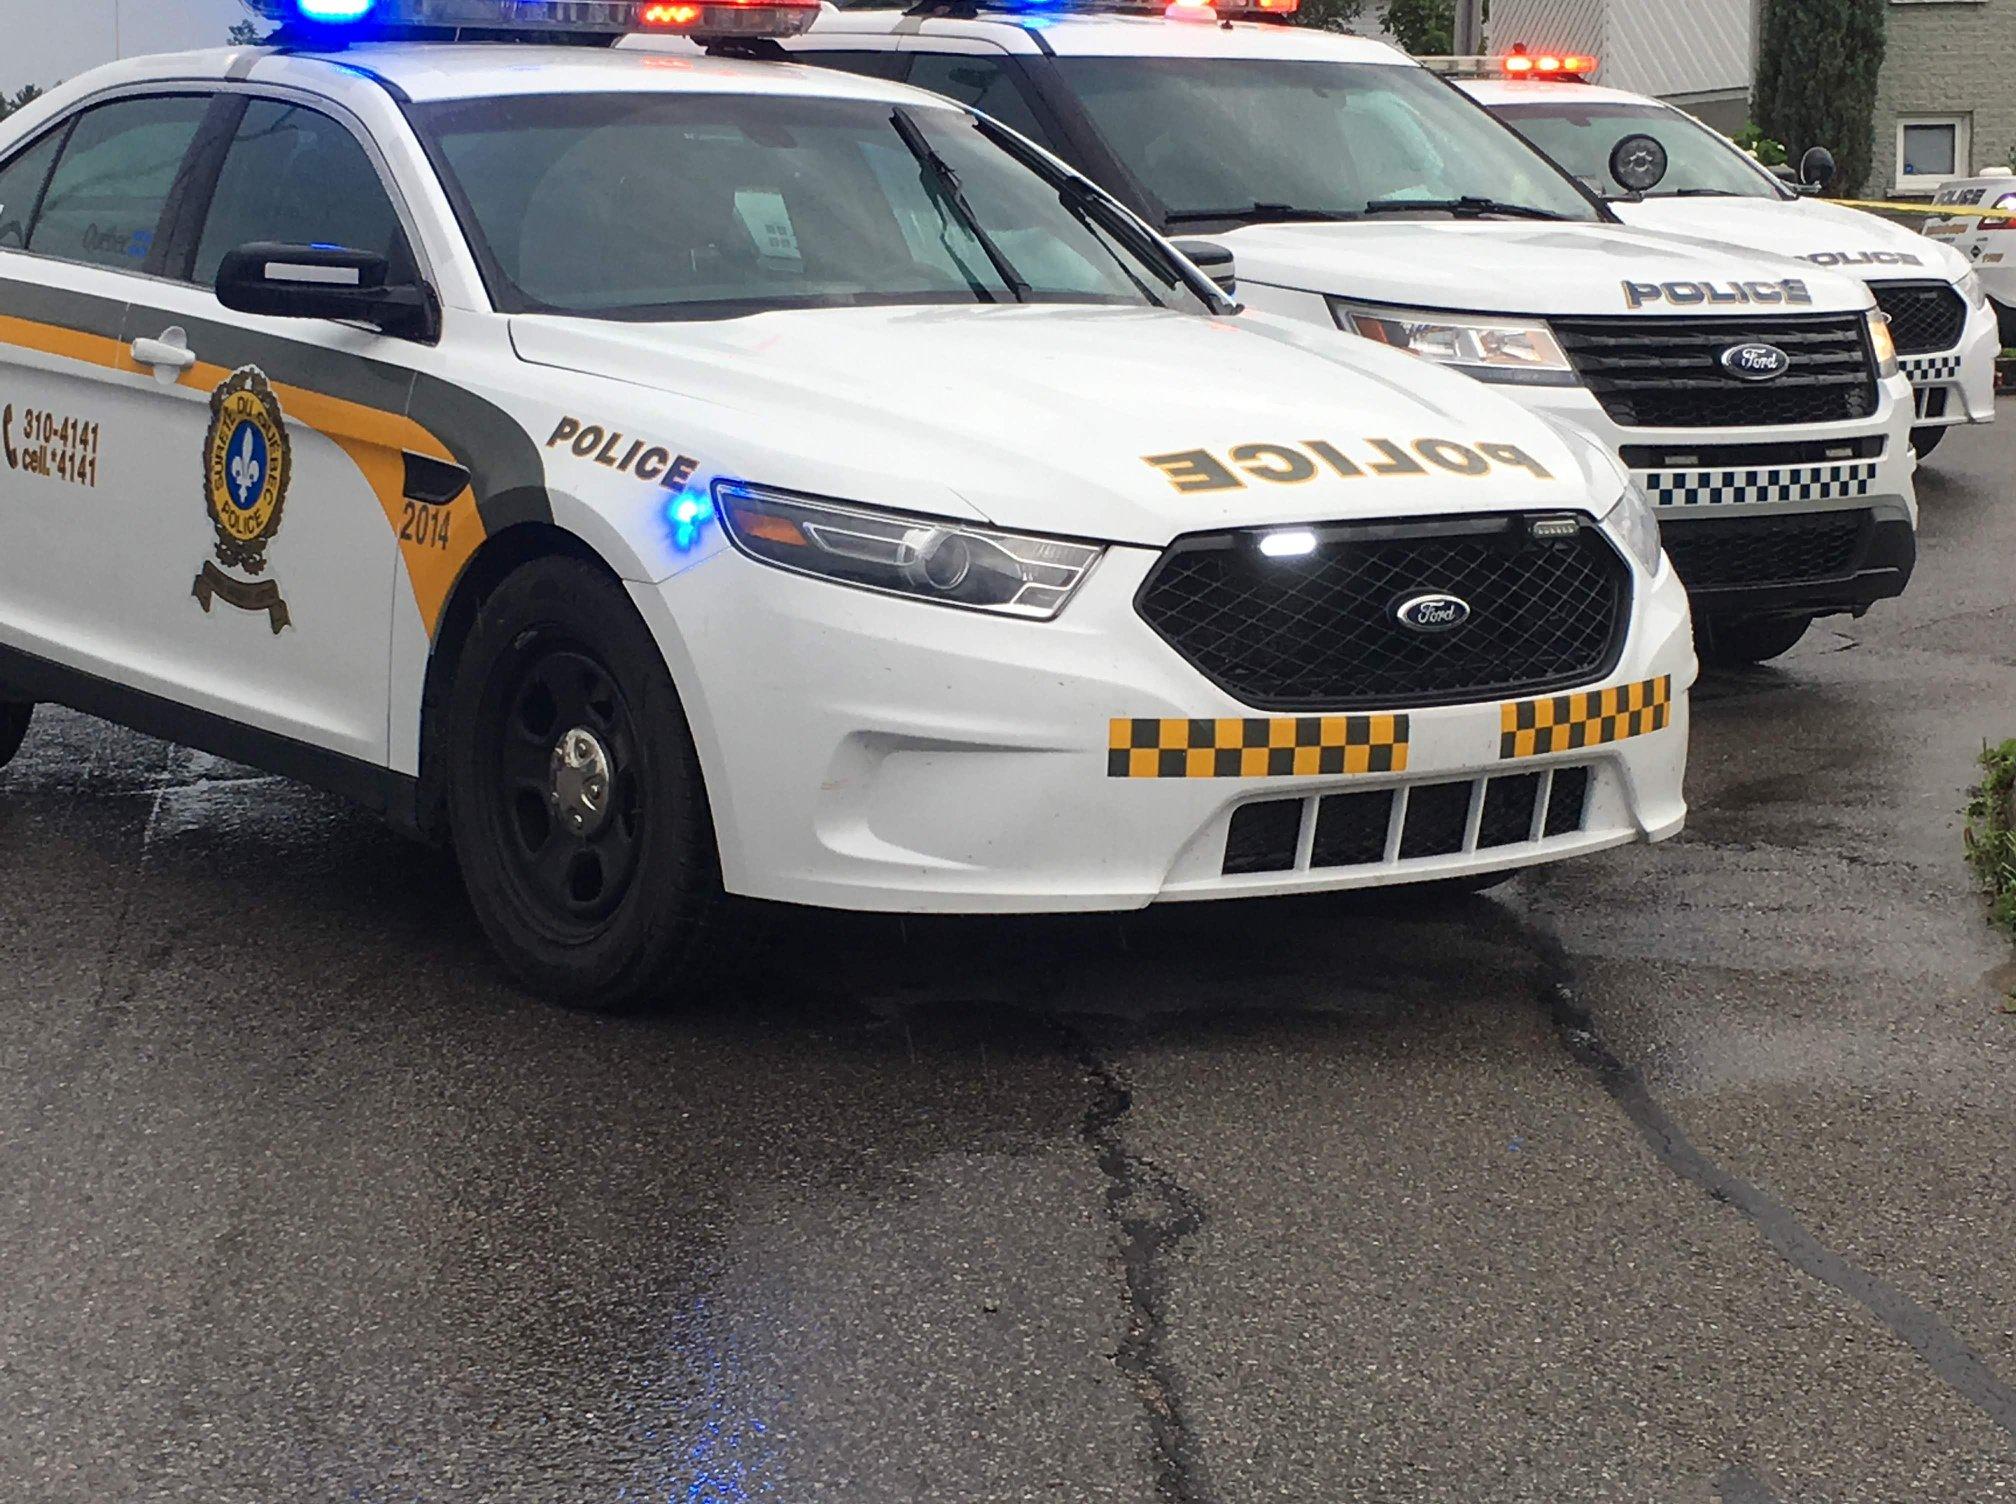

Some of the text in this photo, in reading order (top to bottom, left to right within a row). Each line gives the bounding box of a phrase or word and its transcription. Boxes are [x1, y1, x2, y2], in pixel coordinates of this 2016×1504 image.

[1794, 252, 1924, 267] OLICE
[1620, 278, 1812, 309] POLICE
[1741, 347, 1779, 371] Ford
[236, 396, 254, 418] DU
[23, 408, 99, 454] 310-4141
[546, 415, 700, 493] POLICE
[220, 499, 264, 535] POLICE
[400, 501, 452, 551] 2014
[1418, 601, 1456, 624] Ford
